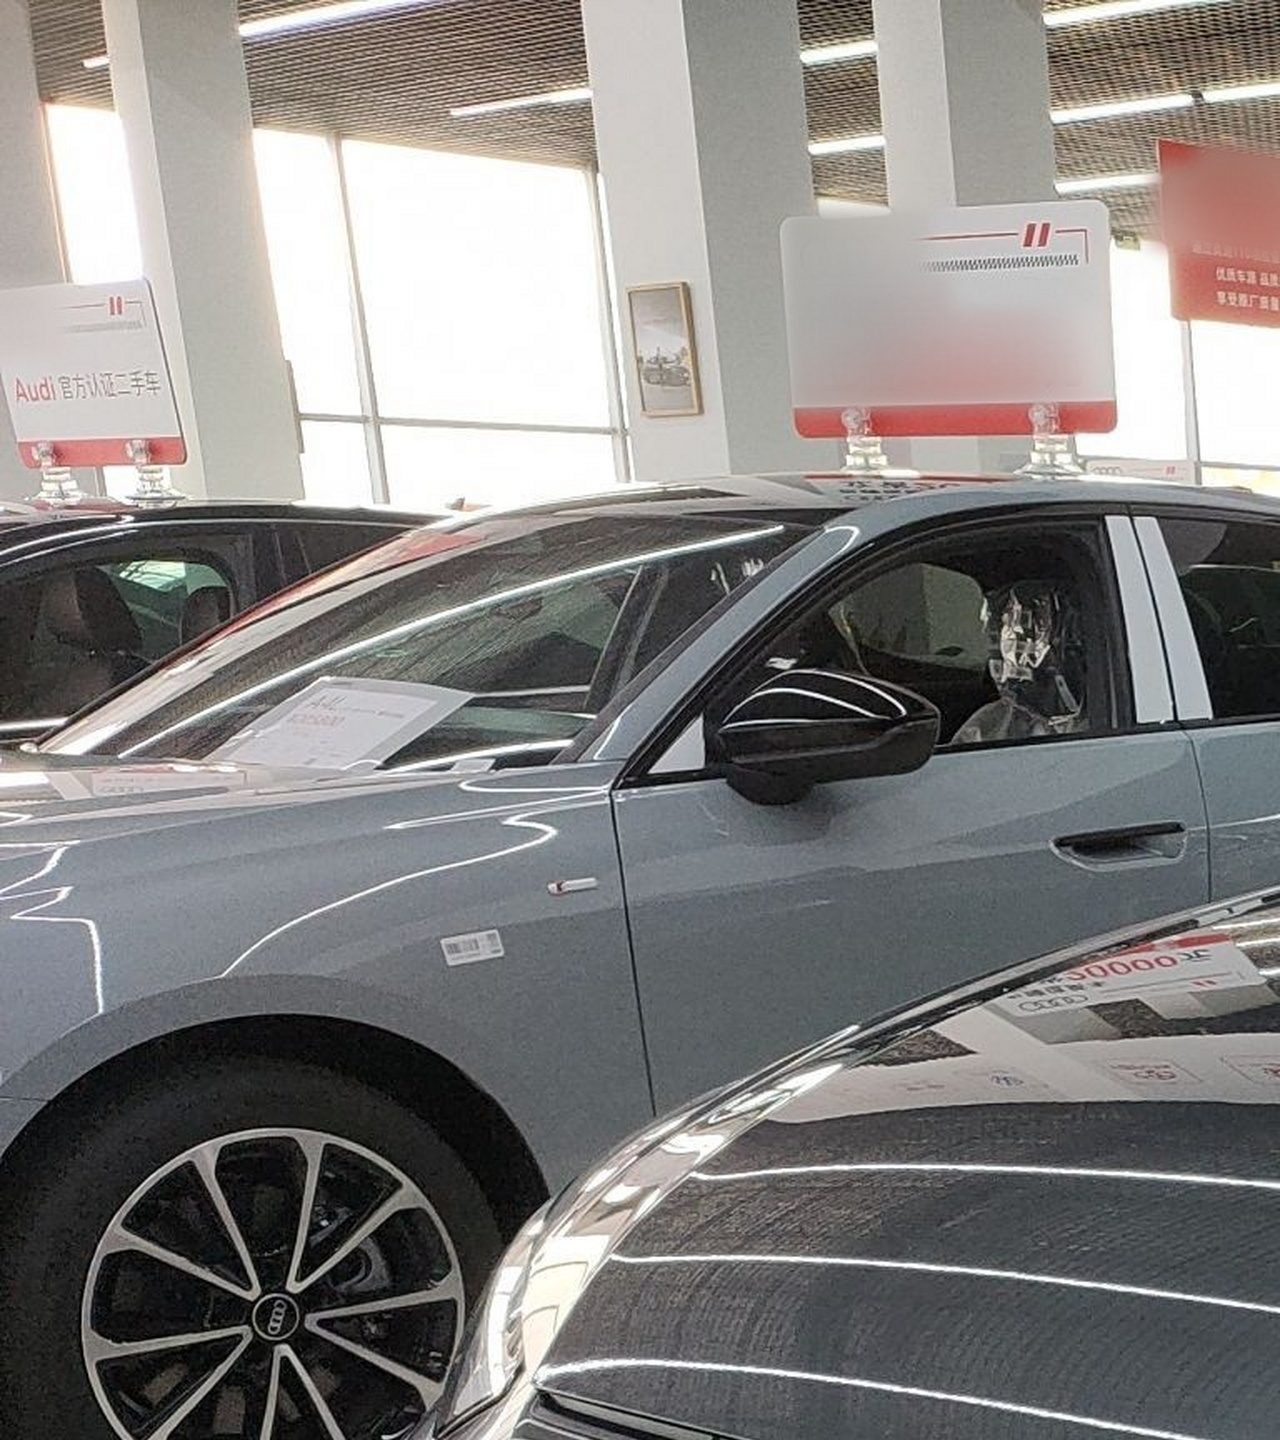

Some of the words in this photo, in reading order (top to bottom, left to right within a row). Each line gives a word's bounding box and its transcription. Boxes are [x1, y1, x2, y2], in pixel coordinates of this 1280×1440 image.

[14, 375, 56, 402] Audi
[58, 368, 161, 400] 官方认证二手车
